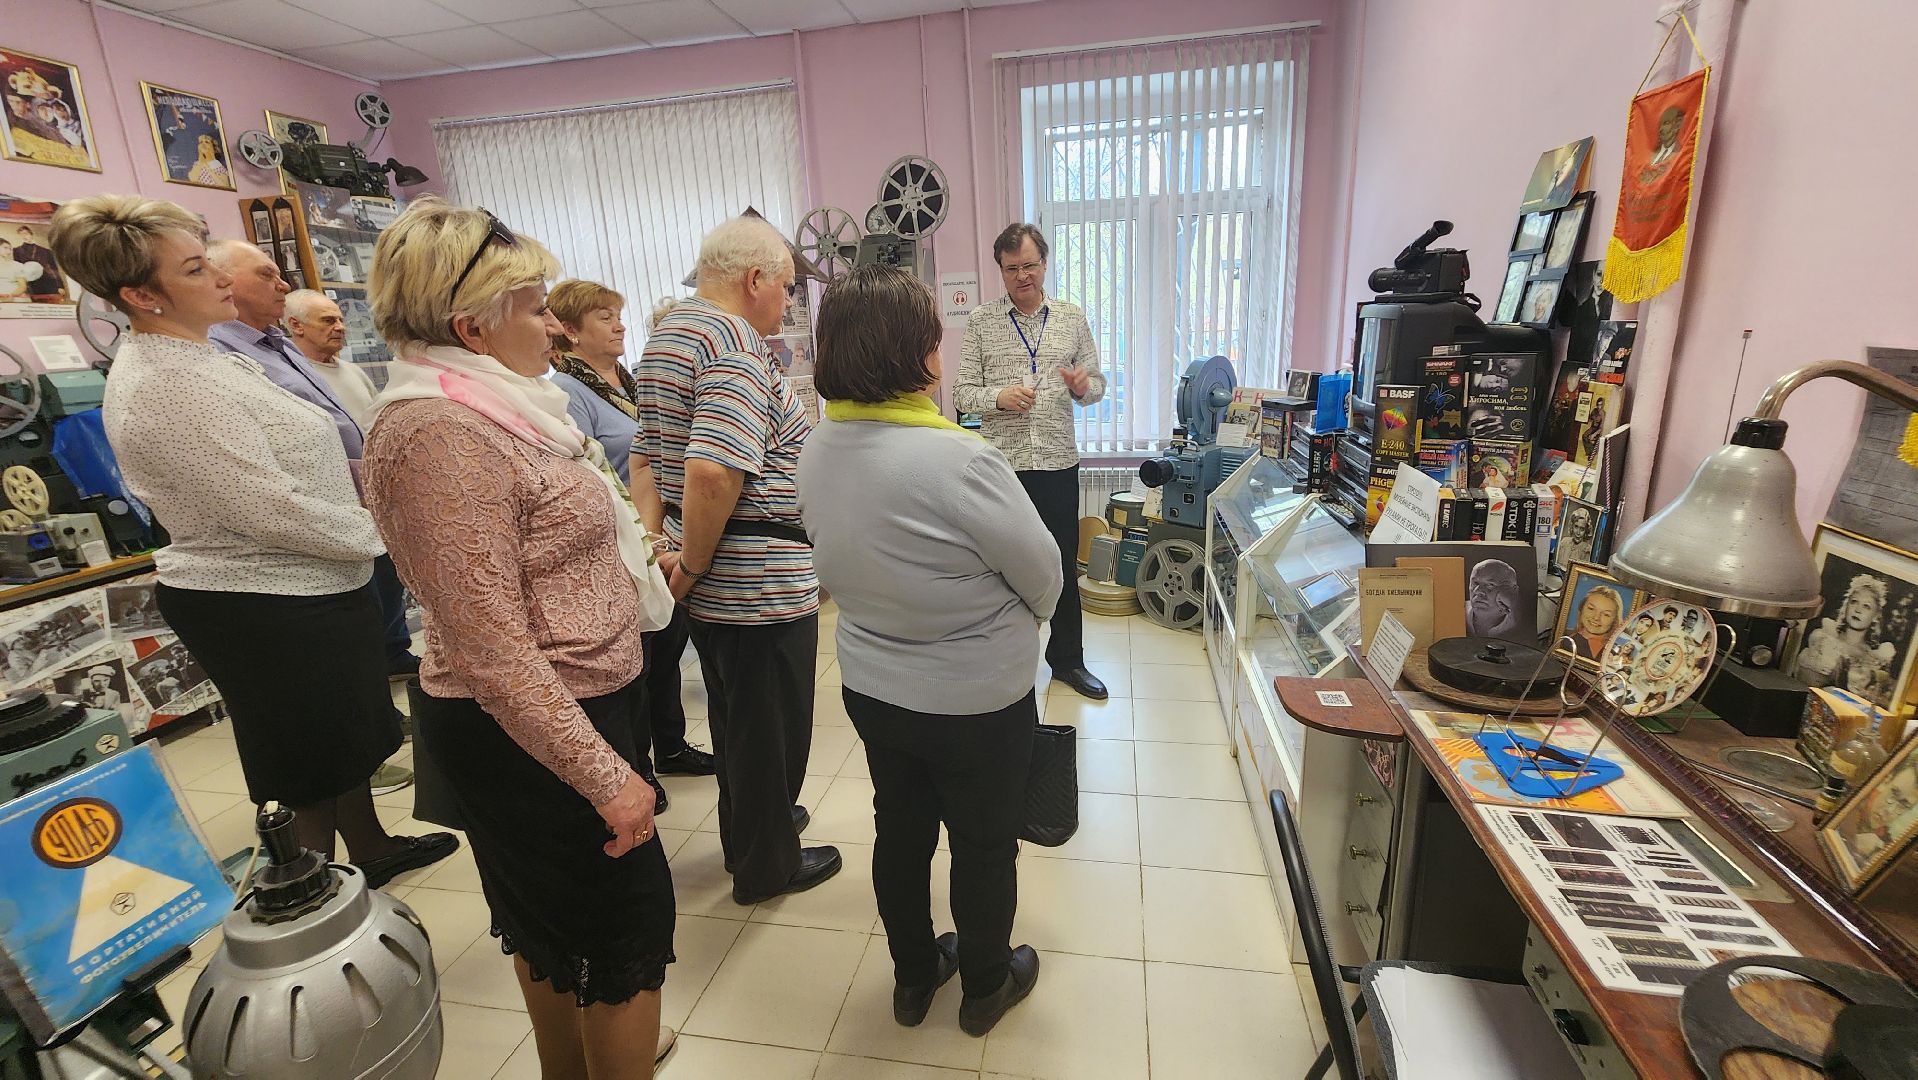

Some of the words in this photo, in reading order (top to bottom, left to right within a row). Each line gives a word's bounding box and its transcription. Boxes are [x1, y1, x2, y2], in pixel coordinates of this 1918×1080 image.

[1389, 389, 1415, 399] BASF
[1381, 439, 1405, 449] E-240
[1508, 507, 1519, 529] TDK
[1524, 508, 1533, 534] SAMSUNG
[1538, 516, 1552, 525] 180
[71, 890, 202, 976] ПОРТАТИВНЫЙ
[79, 902, 208, 985] ФОТОУВЕЛИЧИТЕЛЬ
